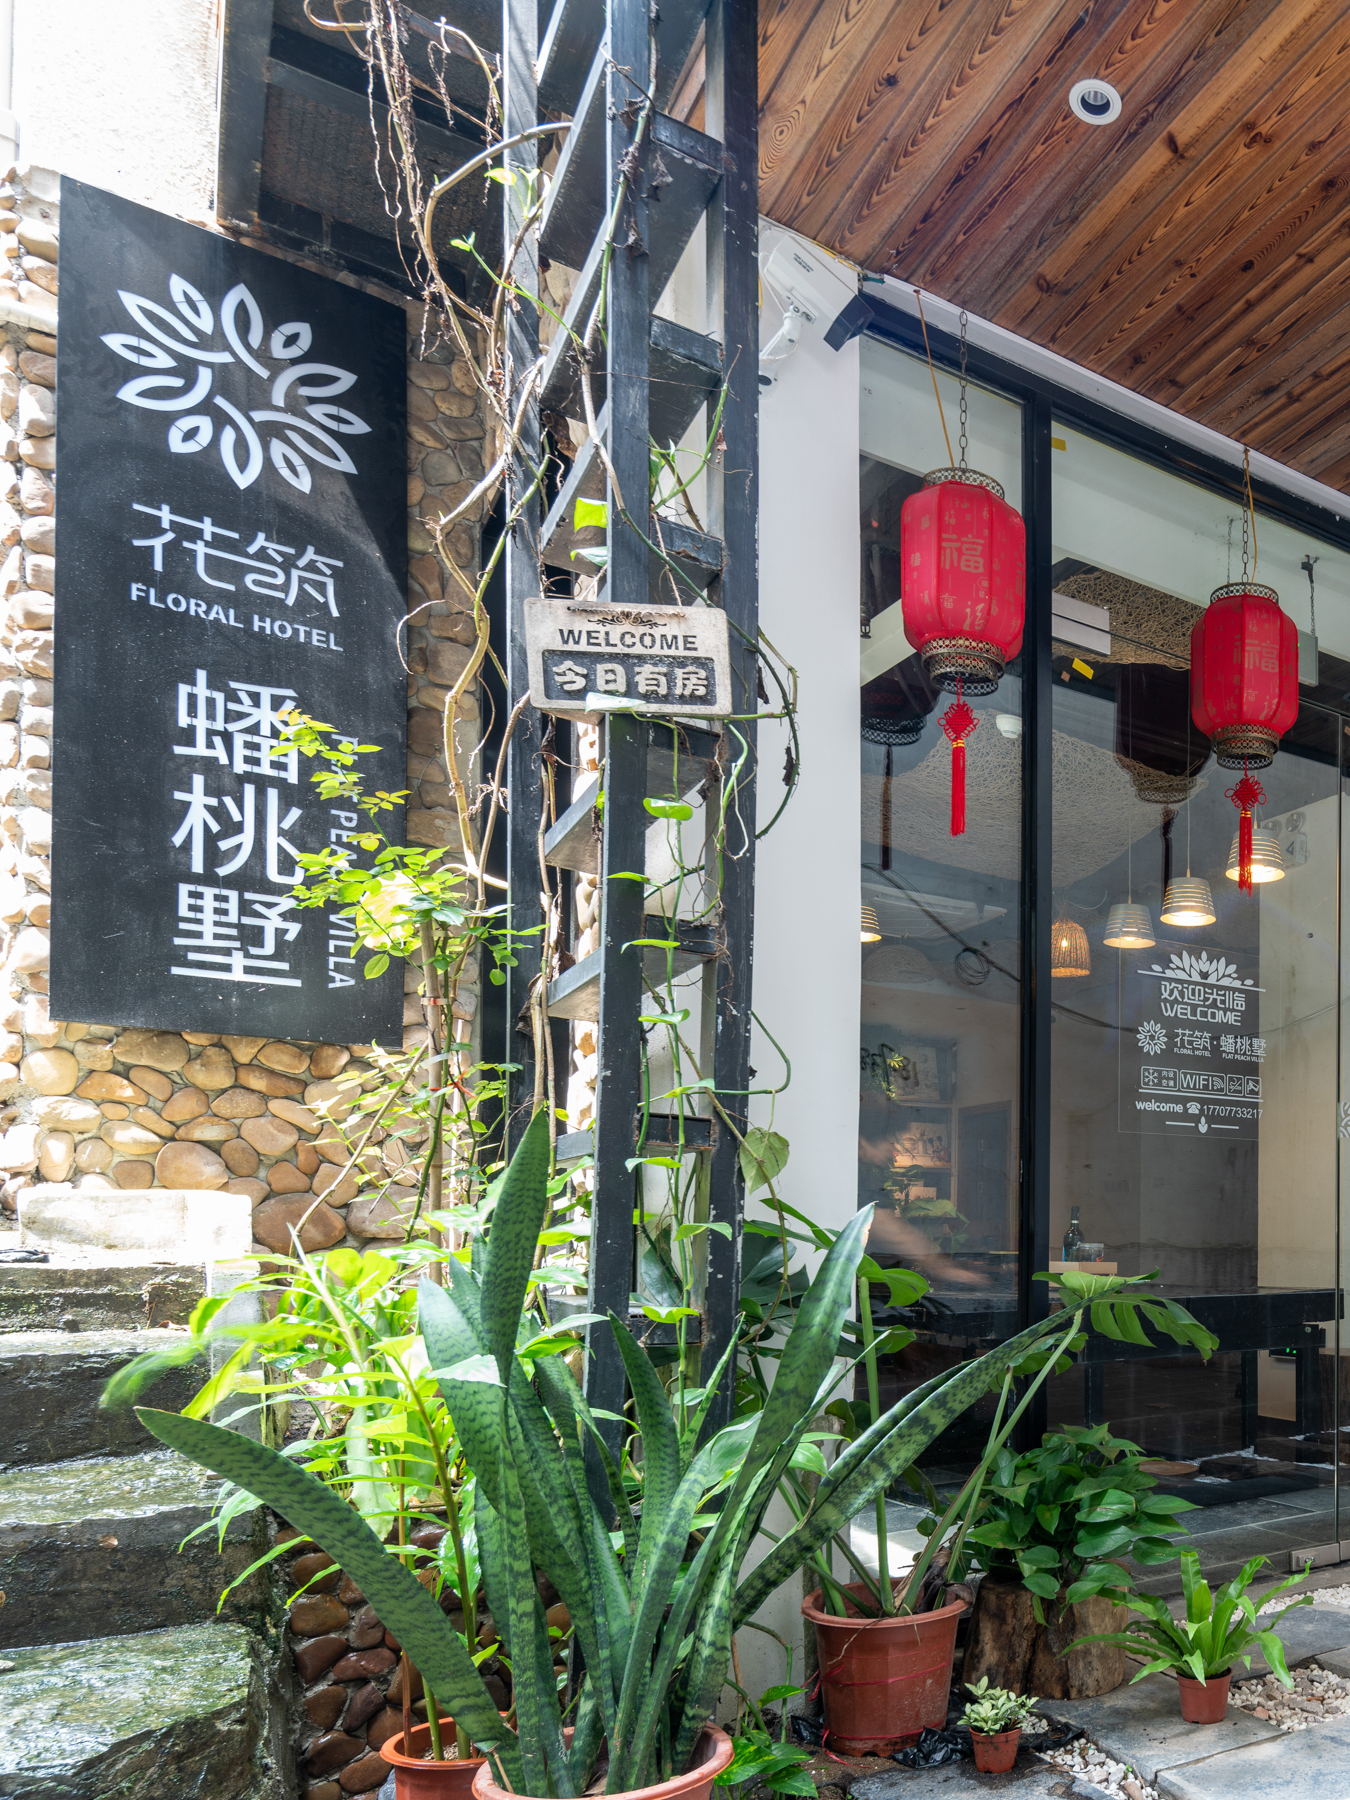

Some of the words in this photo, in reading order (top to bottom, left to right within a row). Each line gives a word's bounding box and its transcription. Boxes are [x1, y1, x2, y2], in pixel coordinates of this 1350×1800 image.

[131, 502, 344, 618] 花筑
[941, 534, 985, 573] 福
[130, 582, 244, 629] FLORAL
[253, 614, 344, 651] HOTEL
[558, 628, 698, 652] WELCOME
[1245, 640, 1279, 673] 福
[552, 660, 708, 697] 今日有房
[170, 668, 305, 988] 蟠桃墅
[328, 913, 357, 989] VILLA
[1160, 981, 1246, 1011] 欢迎光临
[1160, 1002, 1241, 1026] WELCOME
[1174, 1047, 1194, 1055] FLORAL
[1194, 1049, 1212, 1057] HOTEL
[1222, 1052, 1234, 1060] FLAT
[1234, 1053, 1251, 1061] PEACH
[1250, 1055, 1265, 1063] VILLA
[1161, 1070, 1175, 1078] 内设
[1161, 1079, 1175, 1087] 空调
[1181, 1073, 1212, 1090] WIFI
[1135, 1099, 1184, 1113] welcome
[1202, 1104, 1264, 1119] 17707733217
